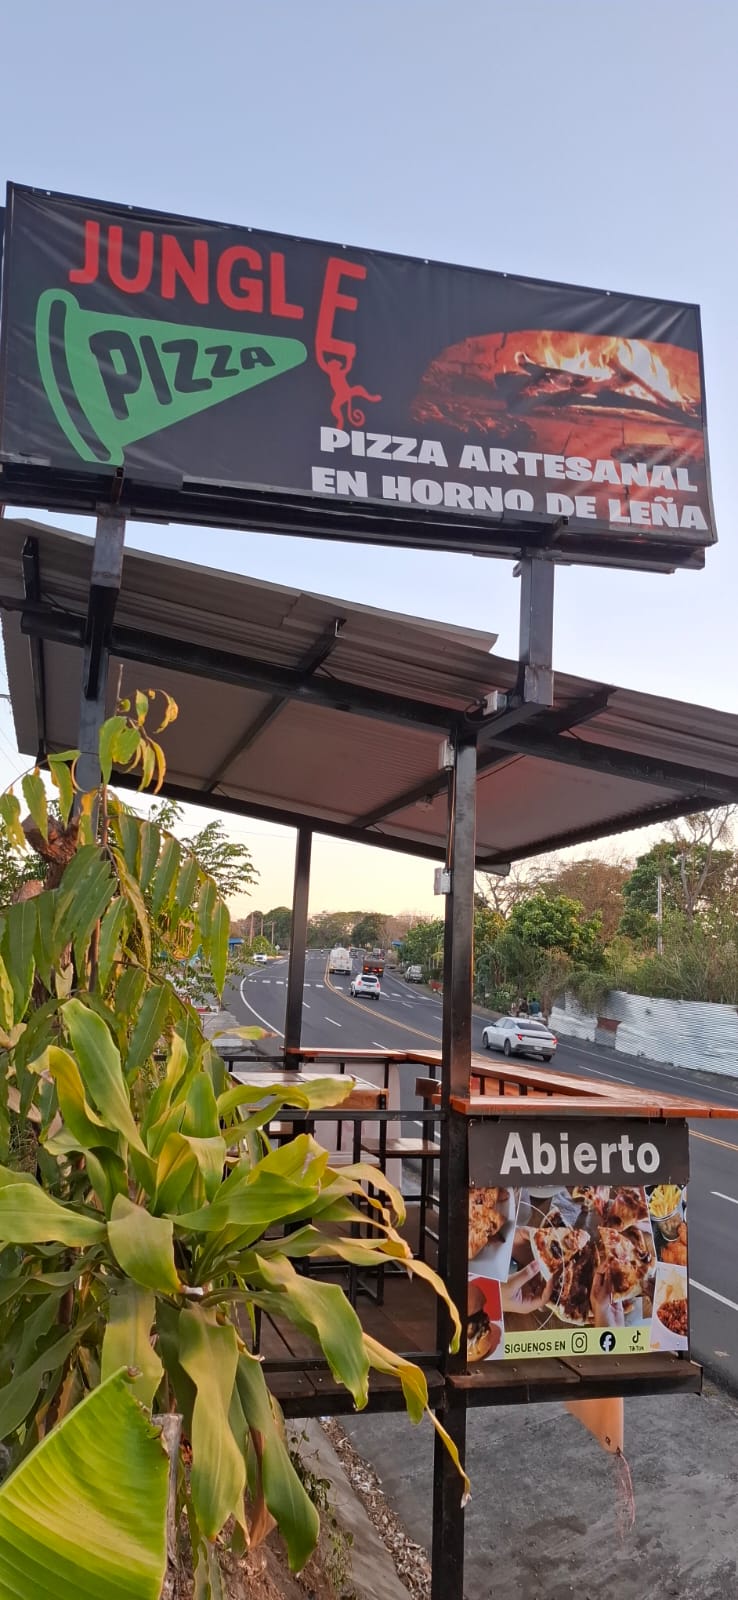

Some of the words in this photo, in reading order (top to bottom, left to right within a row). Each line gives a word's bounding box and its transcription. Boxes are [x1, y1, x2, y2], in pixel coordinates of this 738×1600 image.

[69, 220, 367, 355] JUNGLE
[88, 330, 276, 420] PIZZA
[320, 426, 449, 467] PIZZA
[459, 445, 698, 492] ARTESANAL
[312, 466, 368, 498] EN
[382, 475, 535, 513] HORNO
[546, 492, 597, 519] DE
[608, 496, 708, 530] LEÑA
[500, 1132, 660, 1175] Abierto
[504, 1342, 552, 1354] SIGUENOS
[554, 1341, 566, 1351] EN
